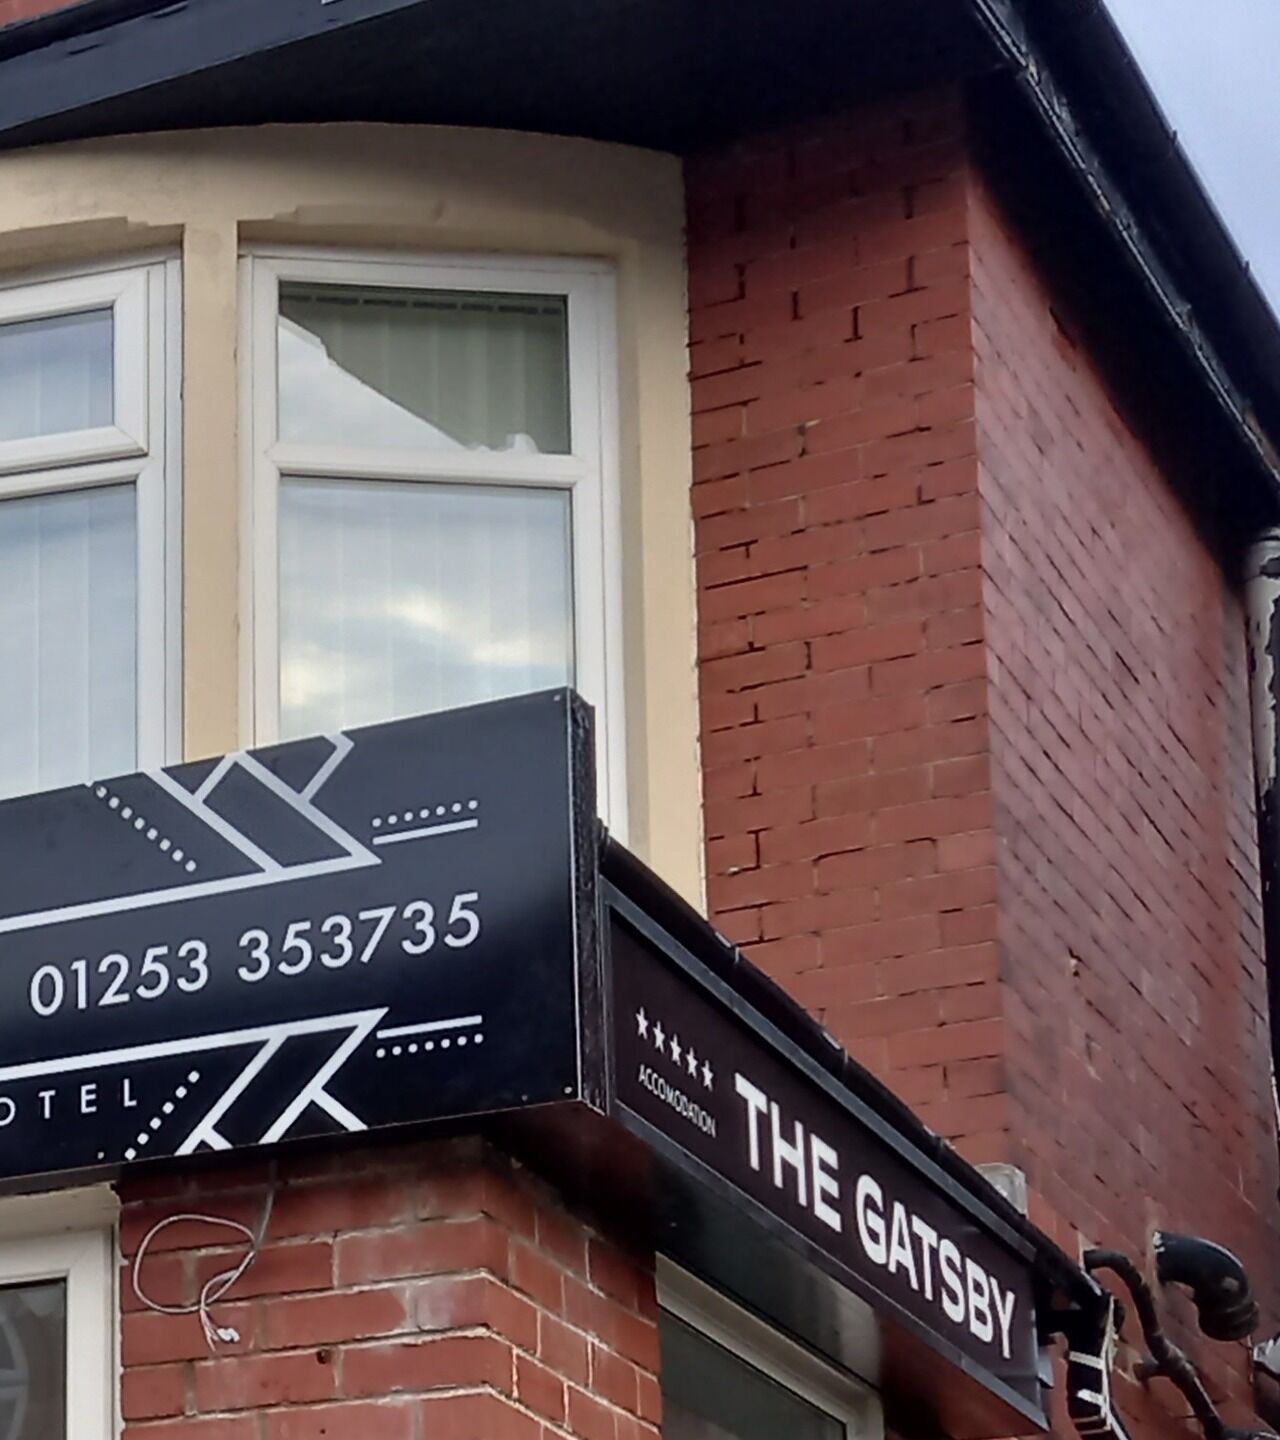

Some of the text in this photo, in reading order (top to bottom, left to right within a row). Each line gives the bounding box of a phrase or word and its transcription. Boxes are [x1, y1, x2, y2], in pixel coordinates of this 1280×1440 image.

[30, 939, 209, 1016] 01253
[238, 892, 481, 982] 353735
[639, 1064, 716, 1138] ACCOMODATION
[735, 1072, 1016, 1359] THE GATSBY
